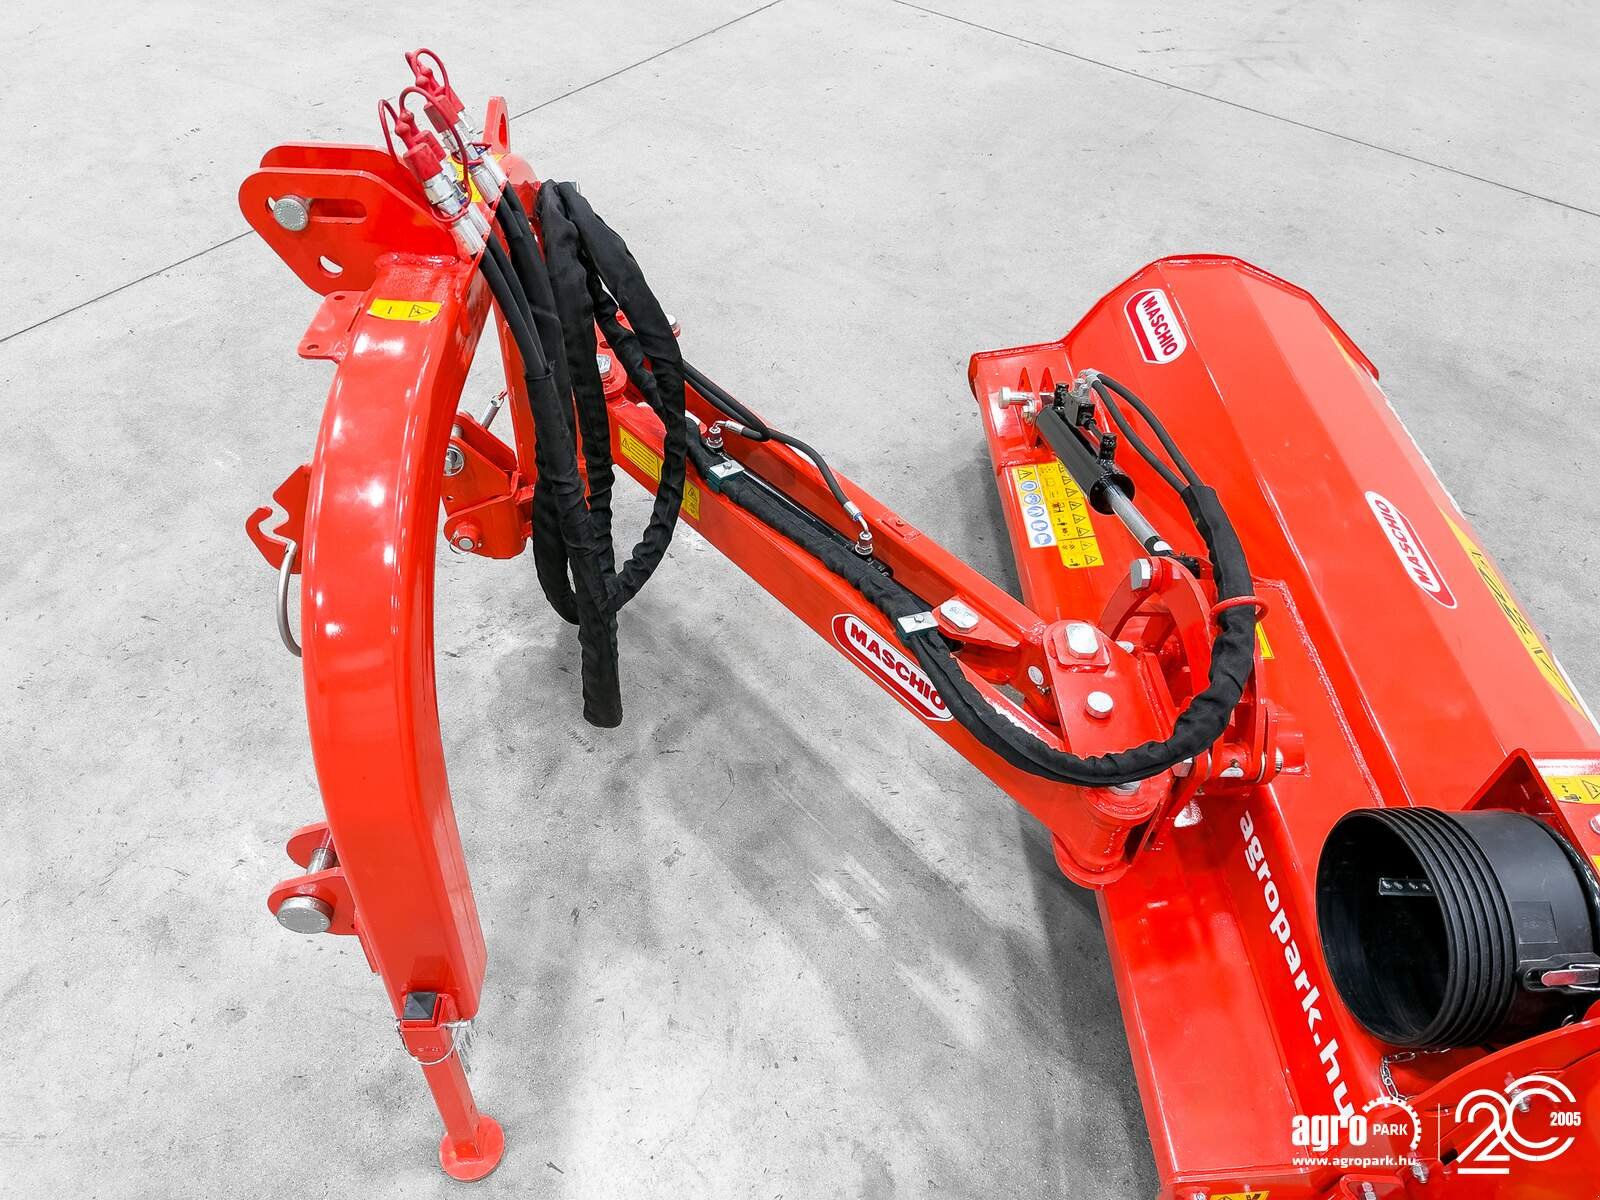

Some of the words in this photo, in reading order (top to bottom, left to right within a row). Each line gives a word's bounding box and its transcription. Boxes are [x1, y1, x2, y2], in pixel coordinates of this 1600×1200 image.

[1141, 295, 1179, 356] MASCHIO
[1374, 499, 1433, 587] MASCHIO
[849, 622, 946, 711] MASCHIO
[1239, 810, 1356, 1120] agropark.hu
